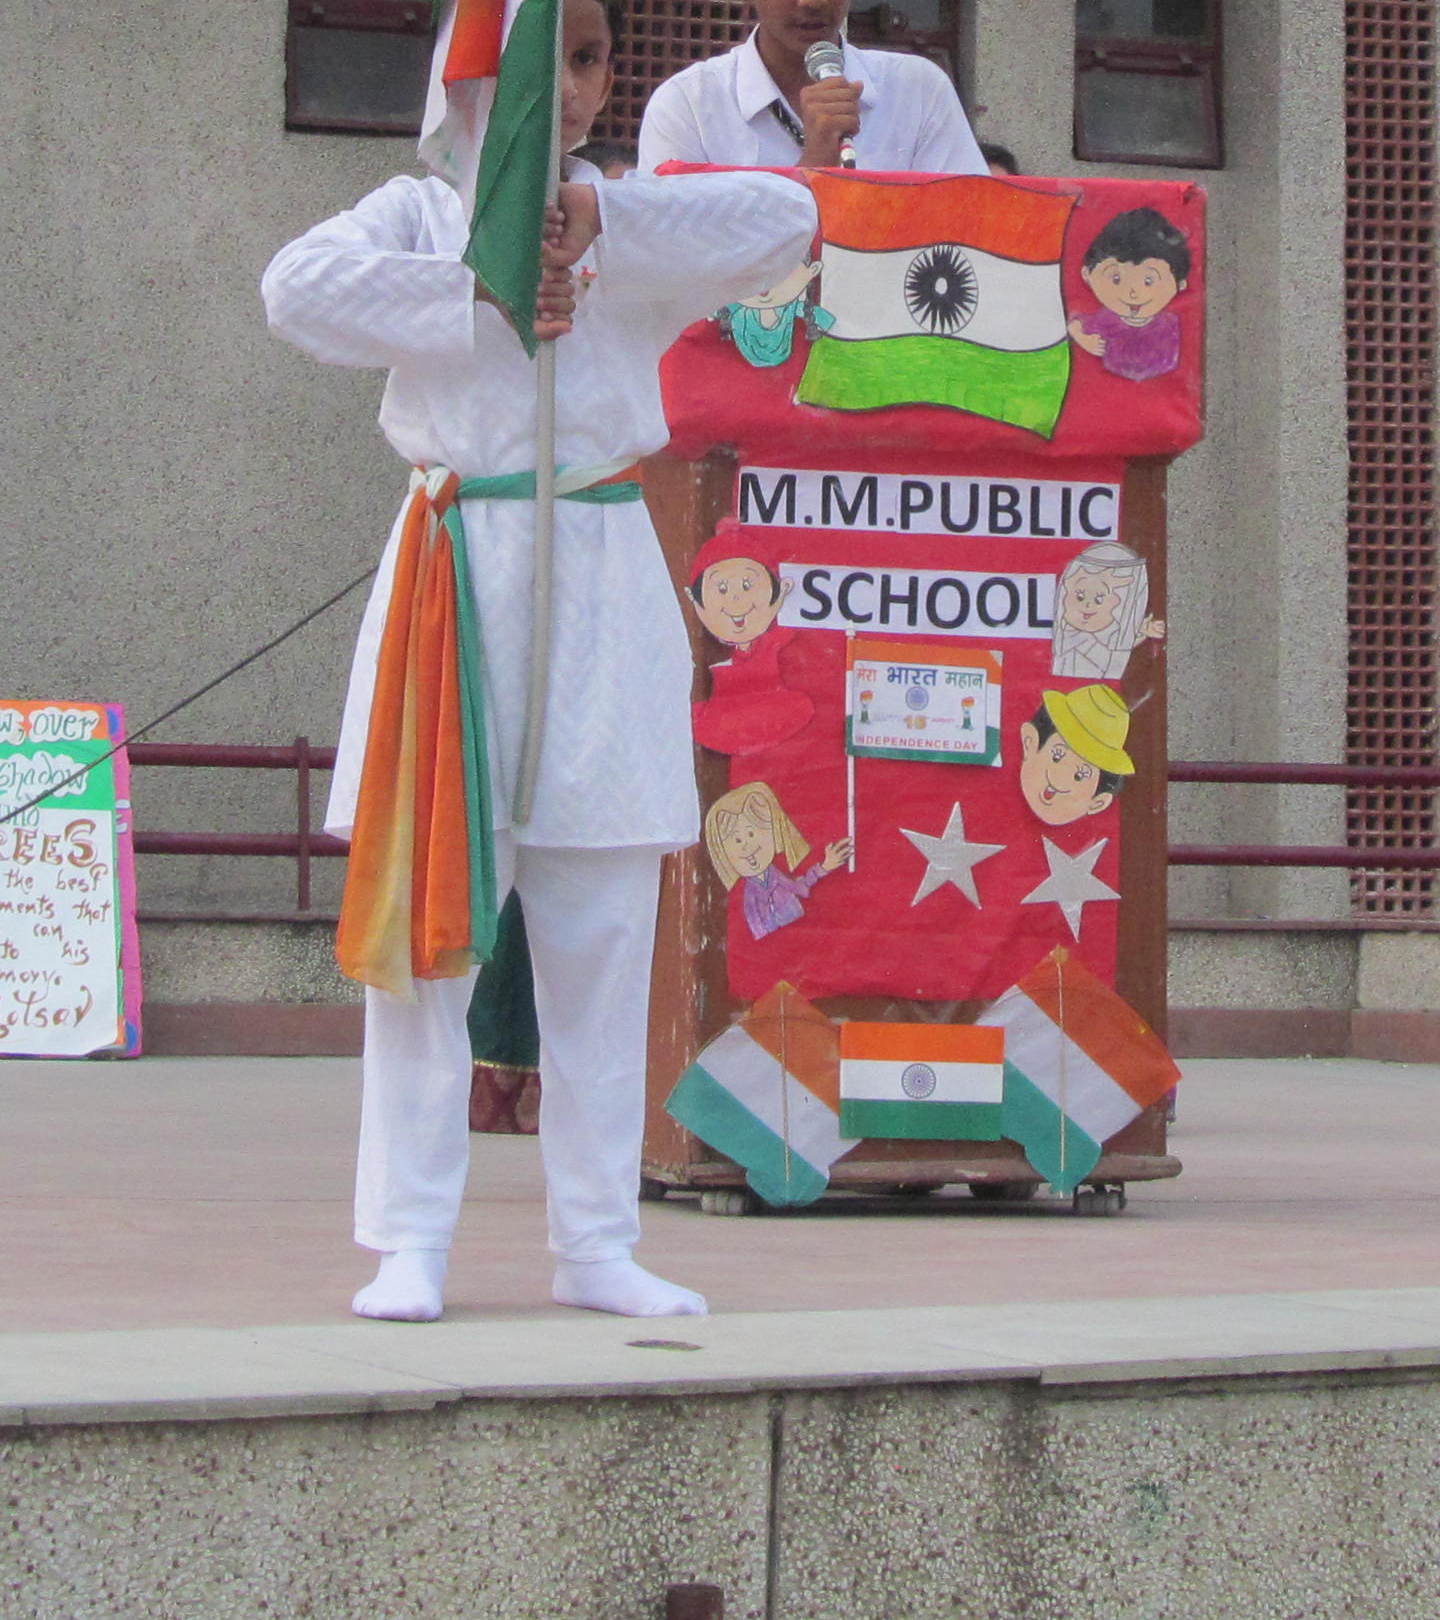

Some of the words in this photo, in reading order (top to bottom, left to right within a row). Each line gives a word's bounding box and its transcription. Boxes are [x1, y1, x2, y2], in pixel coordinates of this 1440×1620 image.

[799, 568, 1054, 630] SCHOOL
[887, 666, 939, 687] भारत
[944, 671, 985, 689] महान
[31, 708, 98, 740] over
[855, 734, 951, 749] INDEPENDENCE
[953, 739, 979, 751] DAY
[3, 869, 34, 895] the
[54, 863, 109, 893] best
[71, 898, 112, 926] that
[32, 922, 64, 941] can
[60, 938, 90, 965] his
